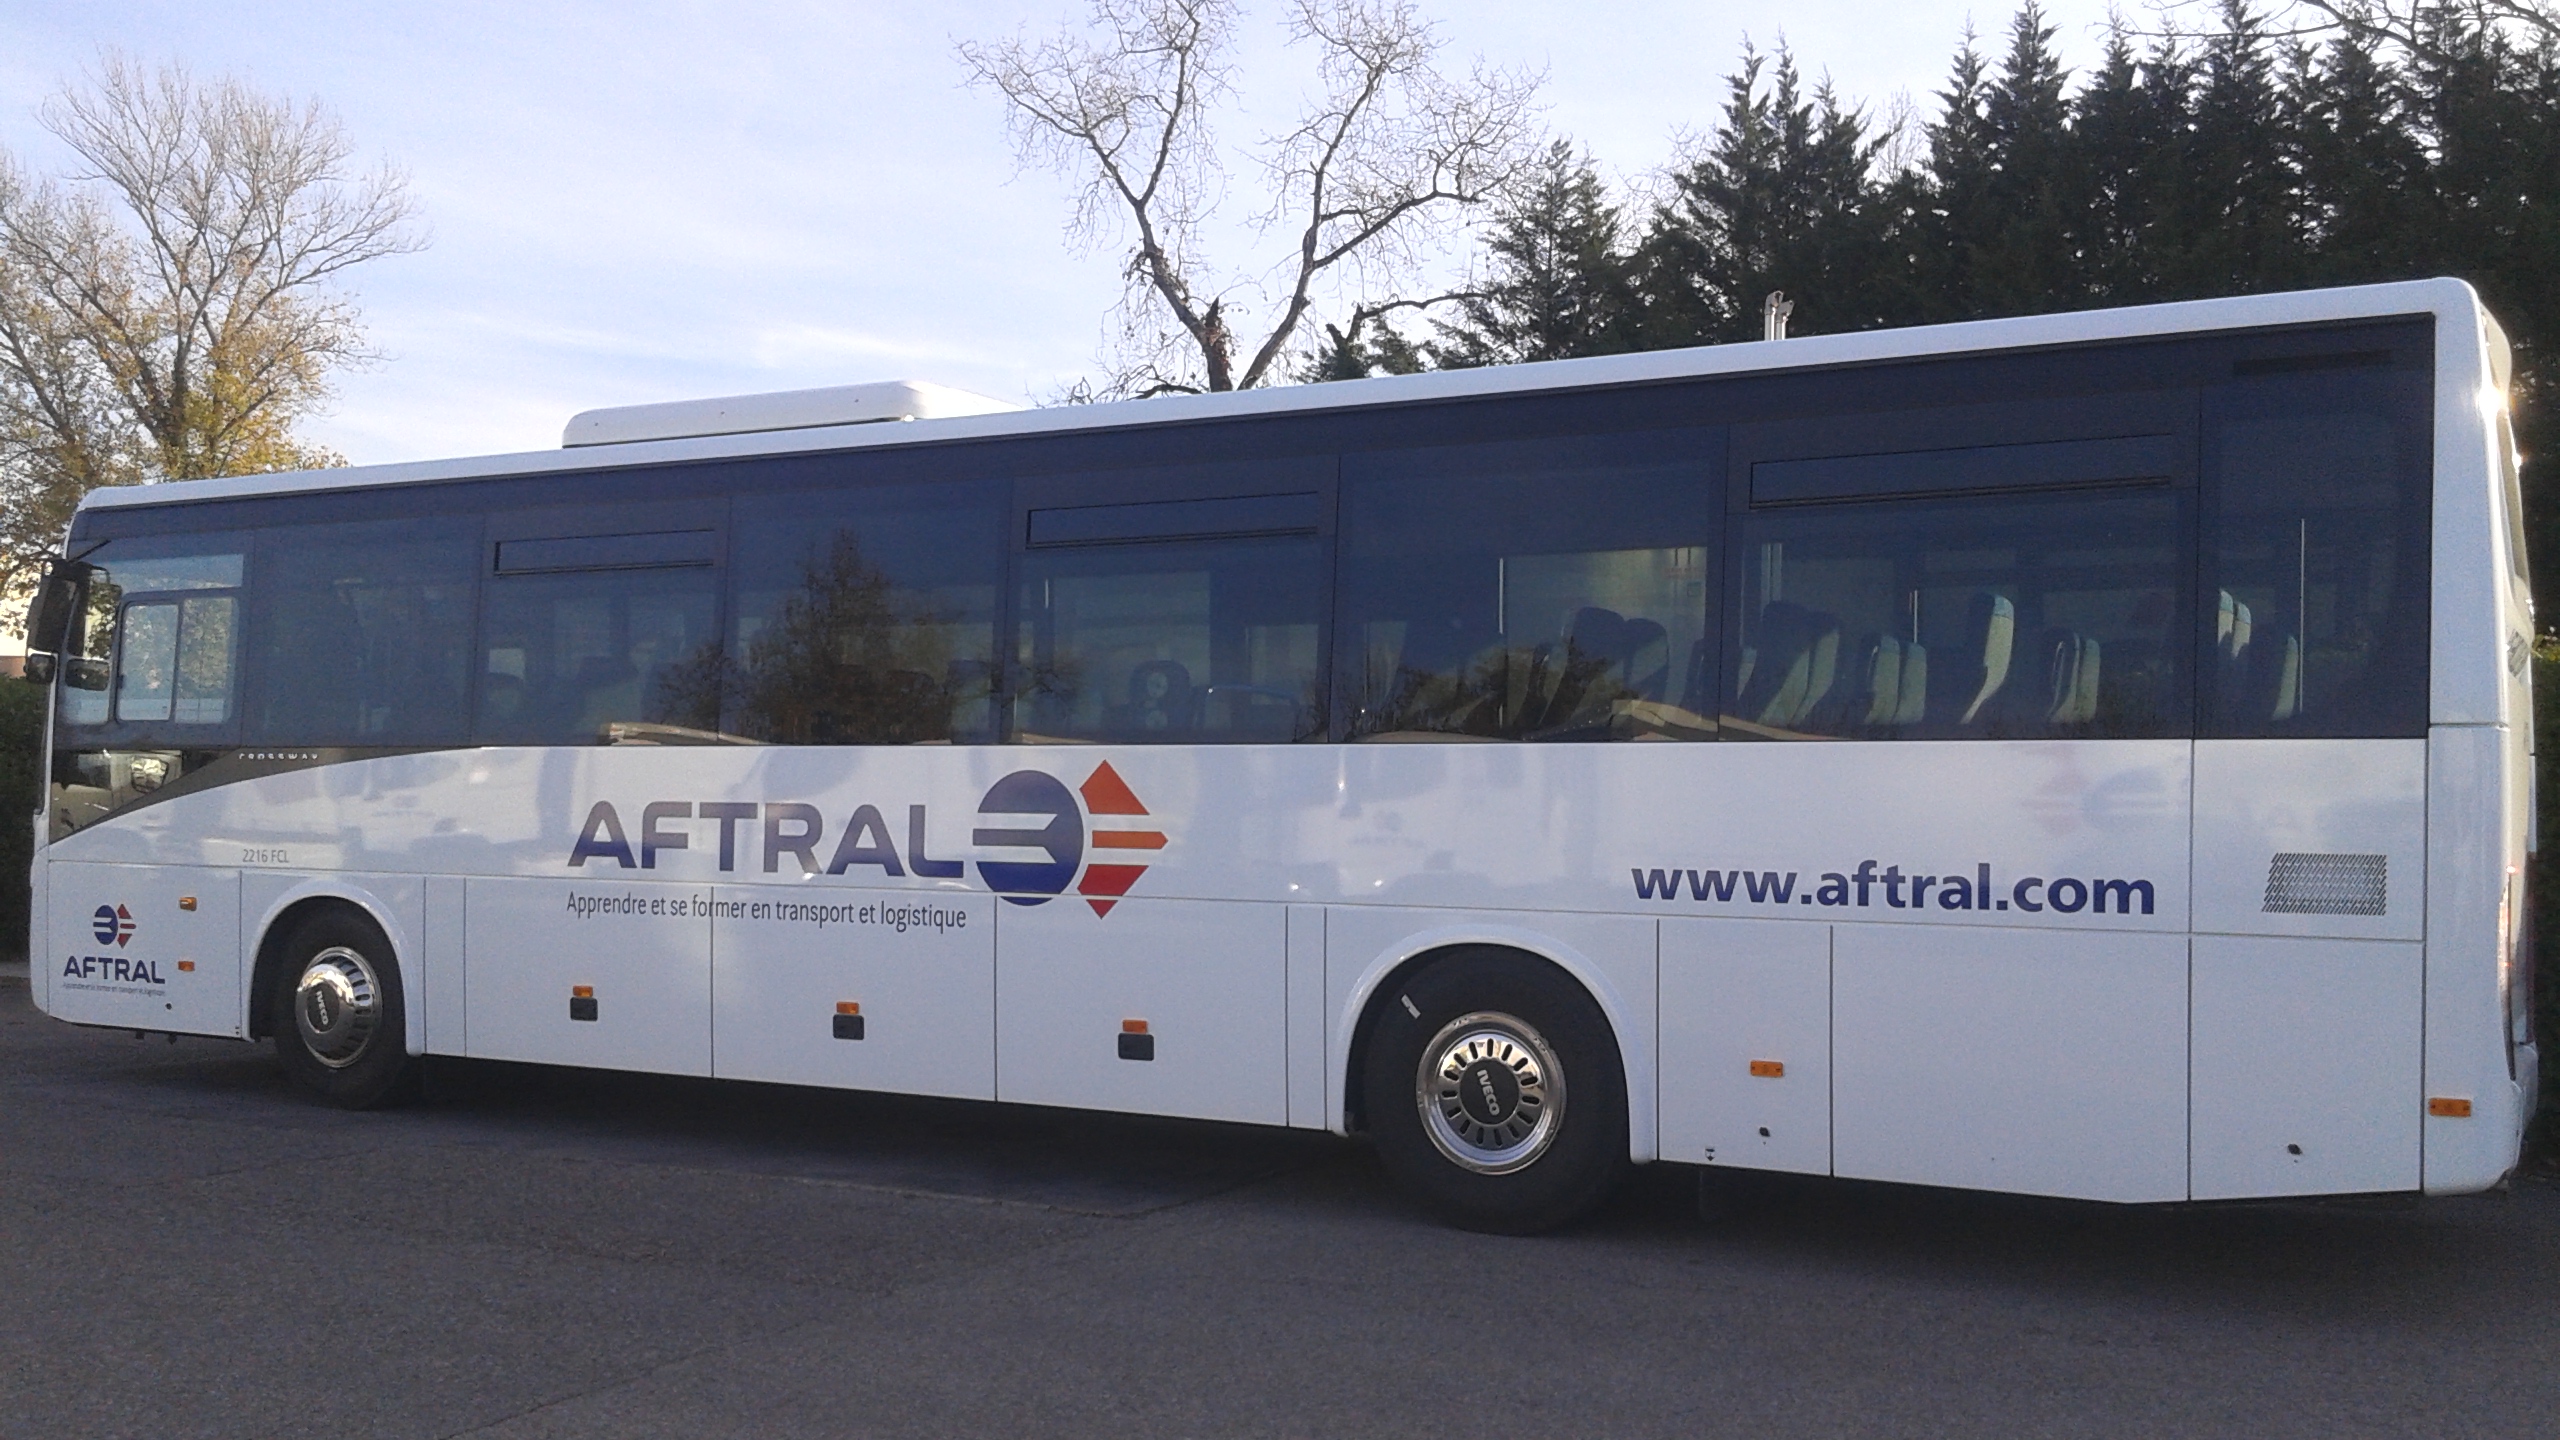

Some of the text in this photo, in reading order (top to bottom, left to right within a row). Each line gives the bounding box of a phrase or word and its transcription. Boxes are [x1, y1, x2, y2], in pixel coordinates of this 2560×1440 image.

[242, 848, 290, 864] 2216 FCL
[567, 800, 964, 879] AFTRAL
[1630, 859, 2156, 916] www.aftral.com
[566, 890, 967, 935] Apprendre et se former en transport et logistique
[63, 955, 165, 984] AFTRAL
[315, 990, 330, 1026] IVECO
[1475, 1069, 1501, 1117] IVECO
